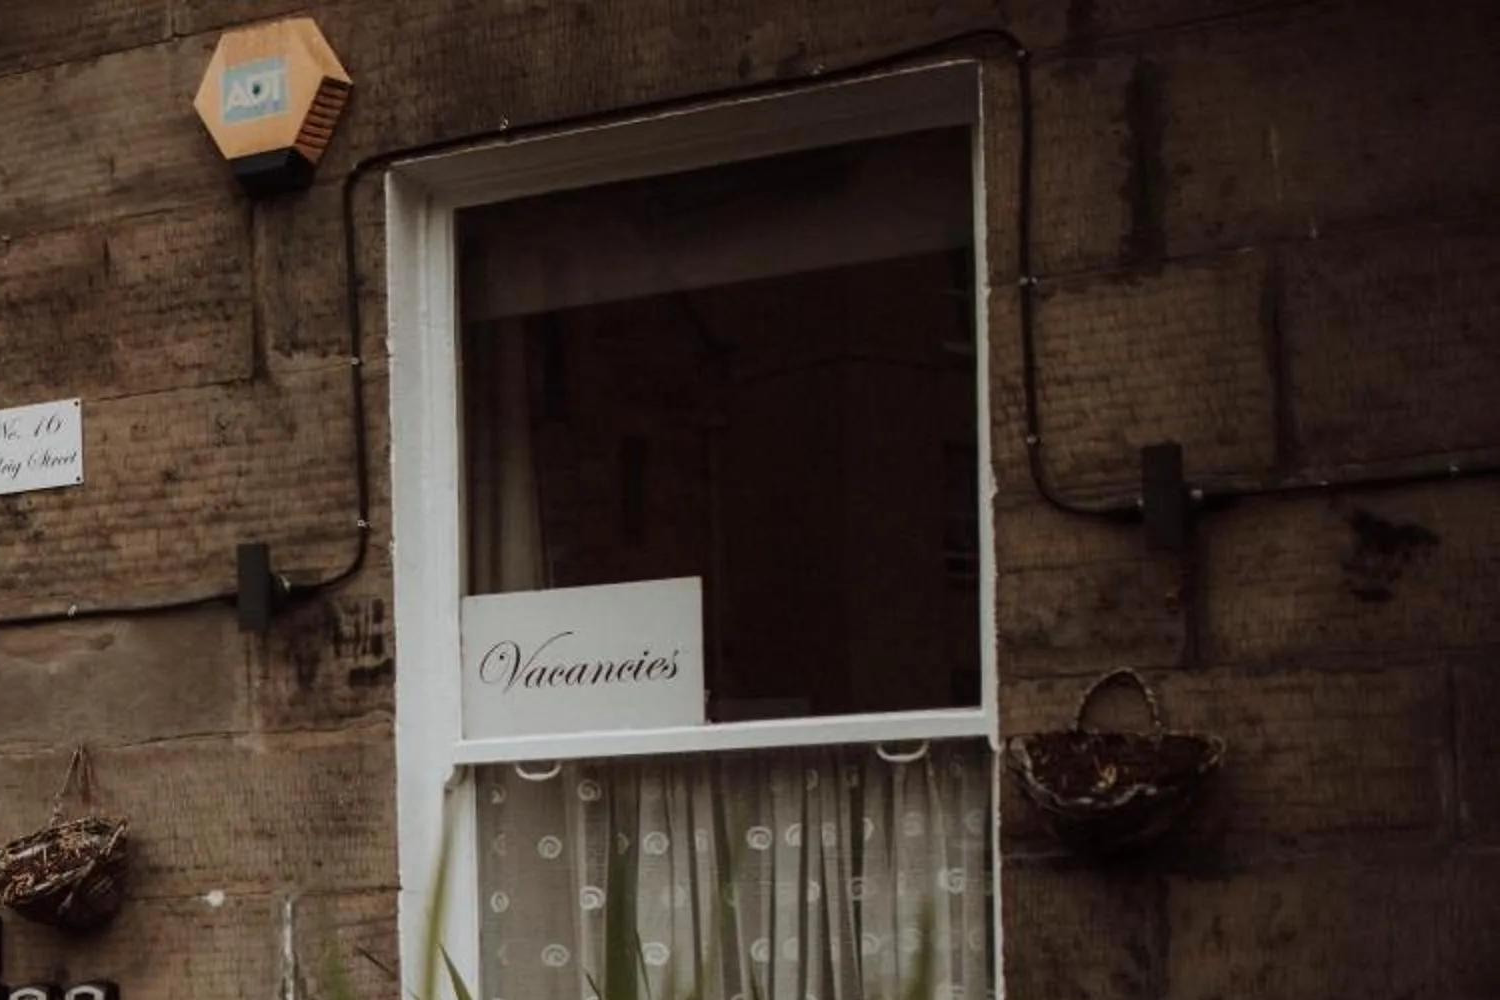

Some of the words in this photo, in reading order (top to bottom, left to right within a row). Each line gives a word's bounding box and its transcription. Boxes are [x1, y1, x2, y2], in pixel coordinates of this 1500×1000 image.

[226, 69, 287, 113] ADT
[33, 413, 68, 438] 16
[27, 447, 78, 469] Street
[479, 630, 681, 695] Vacancies
